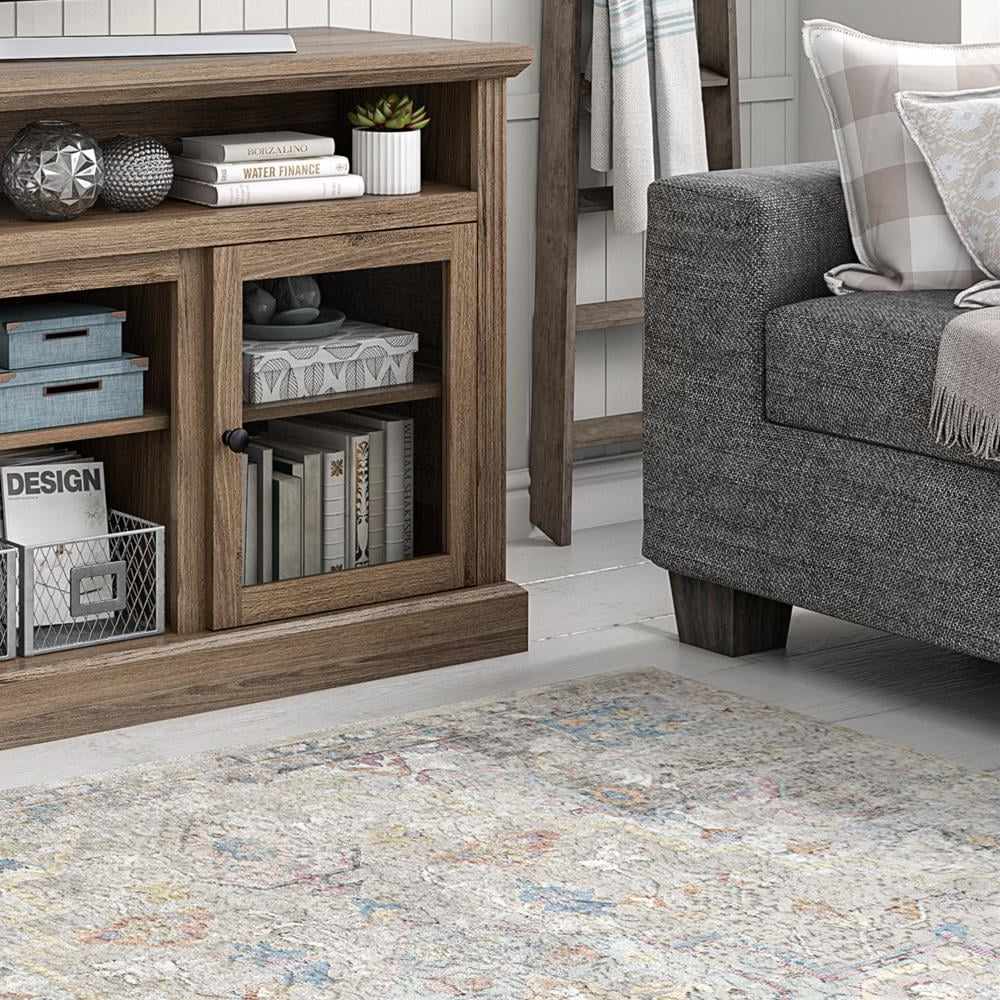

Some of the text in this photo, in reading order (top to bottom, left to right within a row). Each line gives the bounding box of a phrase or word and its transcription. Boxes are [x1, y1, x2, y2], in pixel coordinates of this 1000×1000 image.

[247, 145, 308, 156] BORZALINO
[243, 166, 276, 180] WATER
[279, 163, 321, 177] FINANCE
[403, 422, 413, 480] WILLIAM
[7, 468, 101, 496] DESIGN
